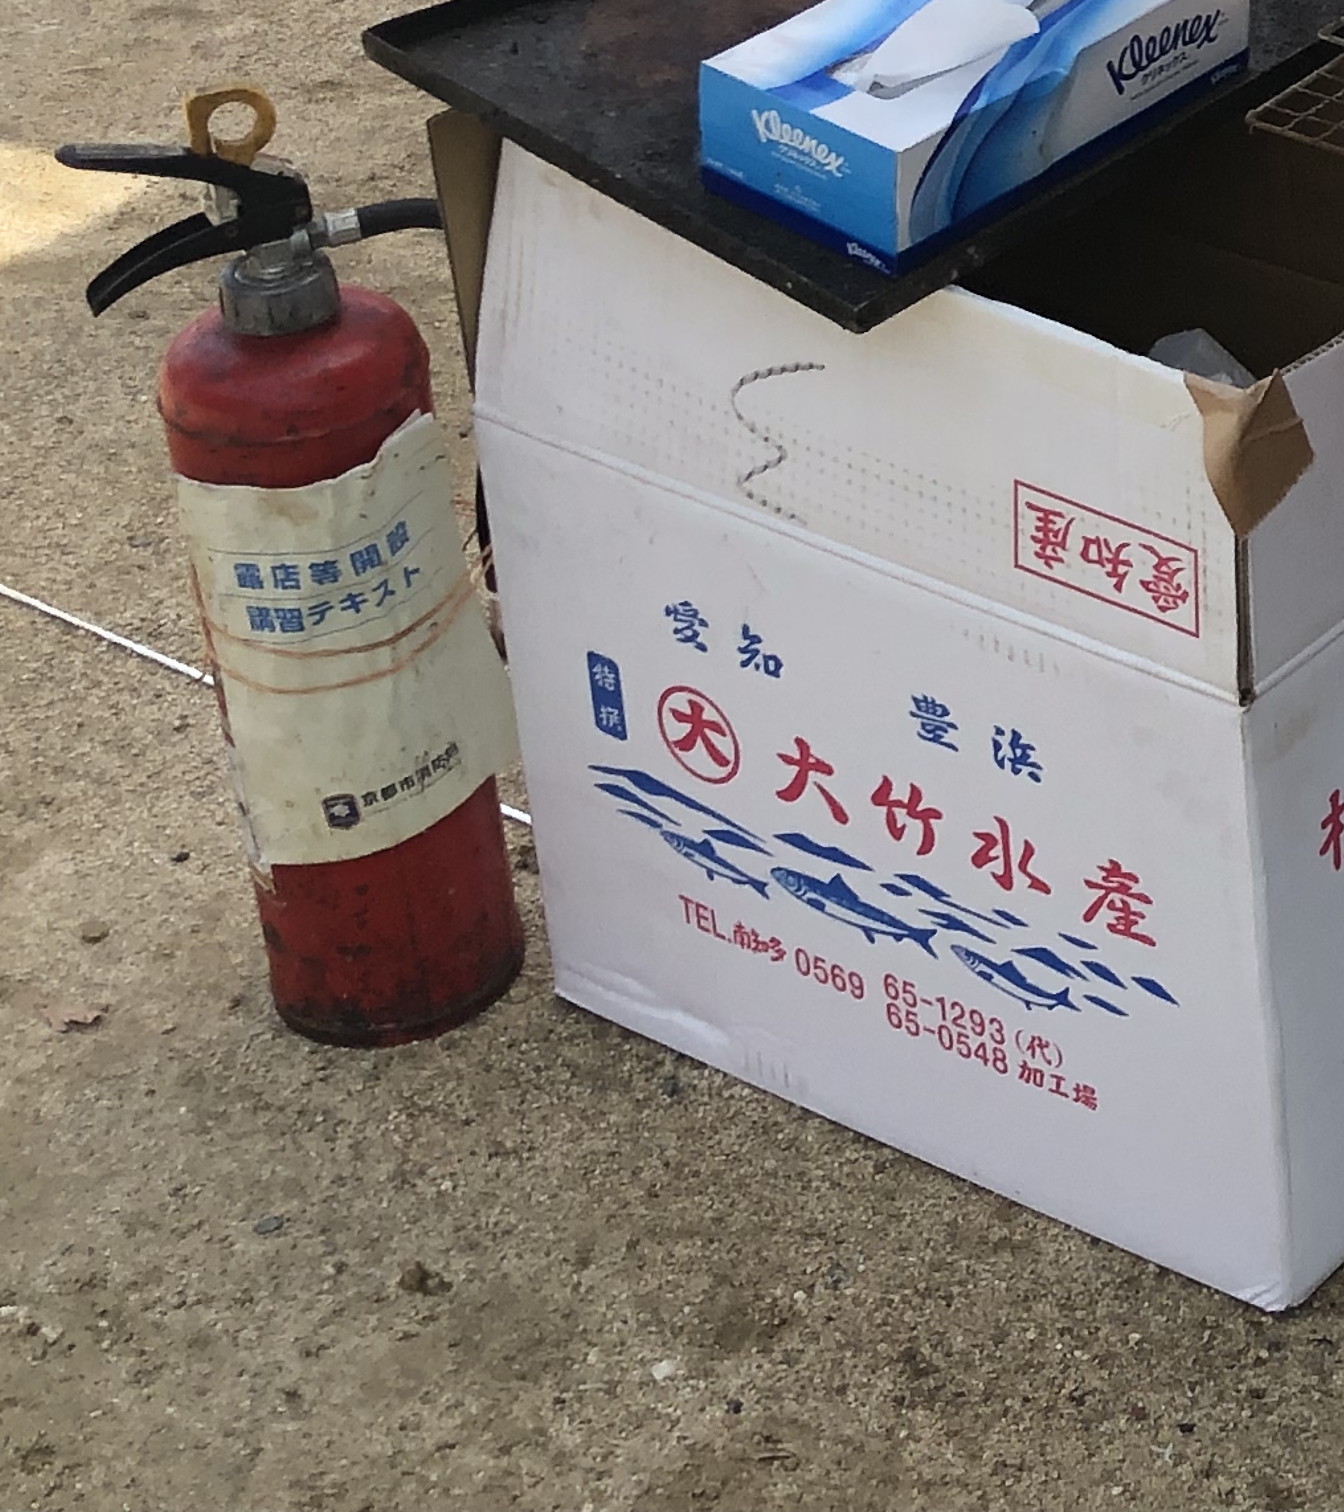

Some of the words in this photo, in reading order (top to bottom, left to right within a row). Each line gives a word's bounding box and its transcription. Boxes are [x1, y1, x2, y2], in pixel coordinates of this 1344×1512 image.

[1107, 9, 1220, 95] Kleenex
[751, 109, 844, 178] Kleenex
[245, 566, 421, 634] 講習テキスト
[1024, 501, 1190, 614] 愛知産
[664, 601, 784, 679] 愛知
[909, 694, 1044, 784] 豊浜
[774, 736, 1158, 948] 大竹水産
[795, 947, 865, 1000] 0569
[883, 973, 1006, 1046] 65-1293
[1015, 1029, 1064, 1070] (代)
[886, 1002, 1009, 1075] 65-0548
[1018, 1059, 1099, 1112] 加工場
